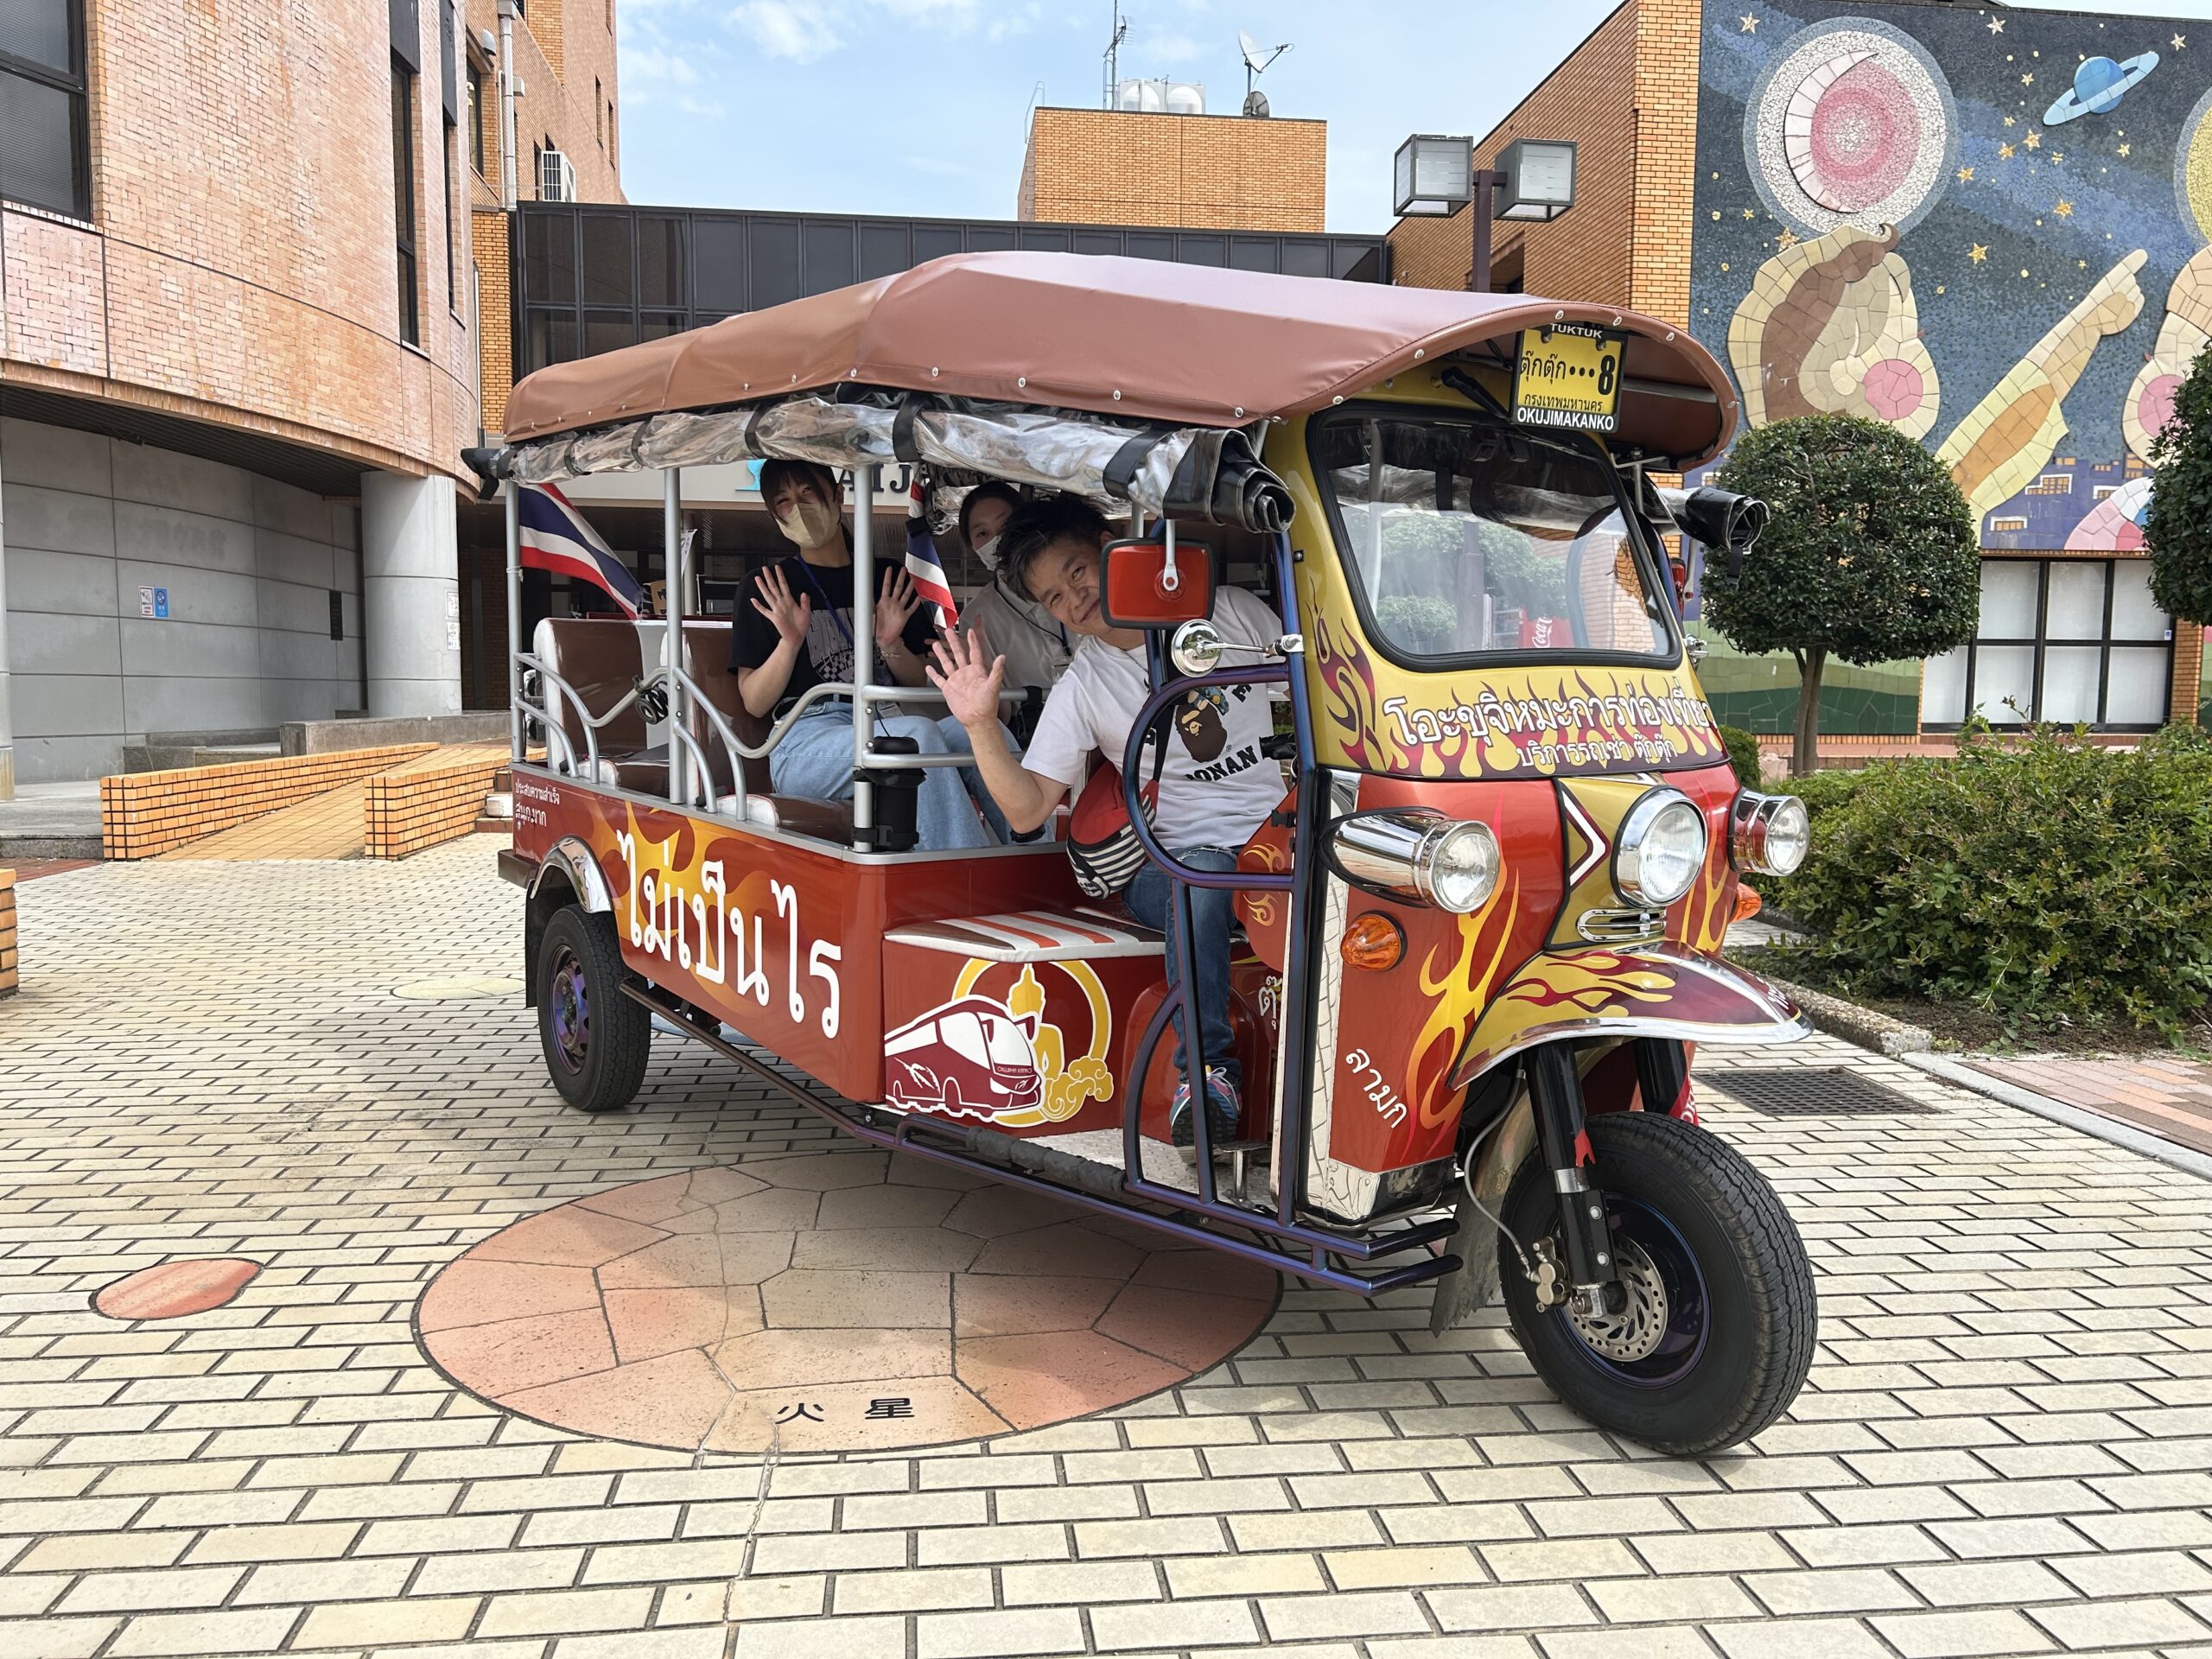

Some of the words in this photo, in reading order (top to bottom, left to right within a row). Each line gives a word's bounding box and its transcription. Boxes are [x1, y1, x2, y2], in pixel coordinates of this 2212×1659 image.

[1550, 323, 1603, 340] TUKTUK
[1185, 745, 1259, 782] ONAN
[1516, 734, 1632, 767] บริการรถเช่า
[1633, 732, 1678, 764] ตุ๊กตุ๊ก
